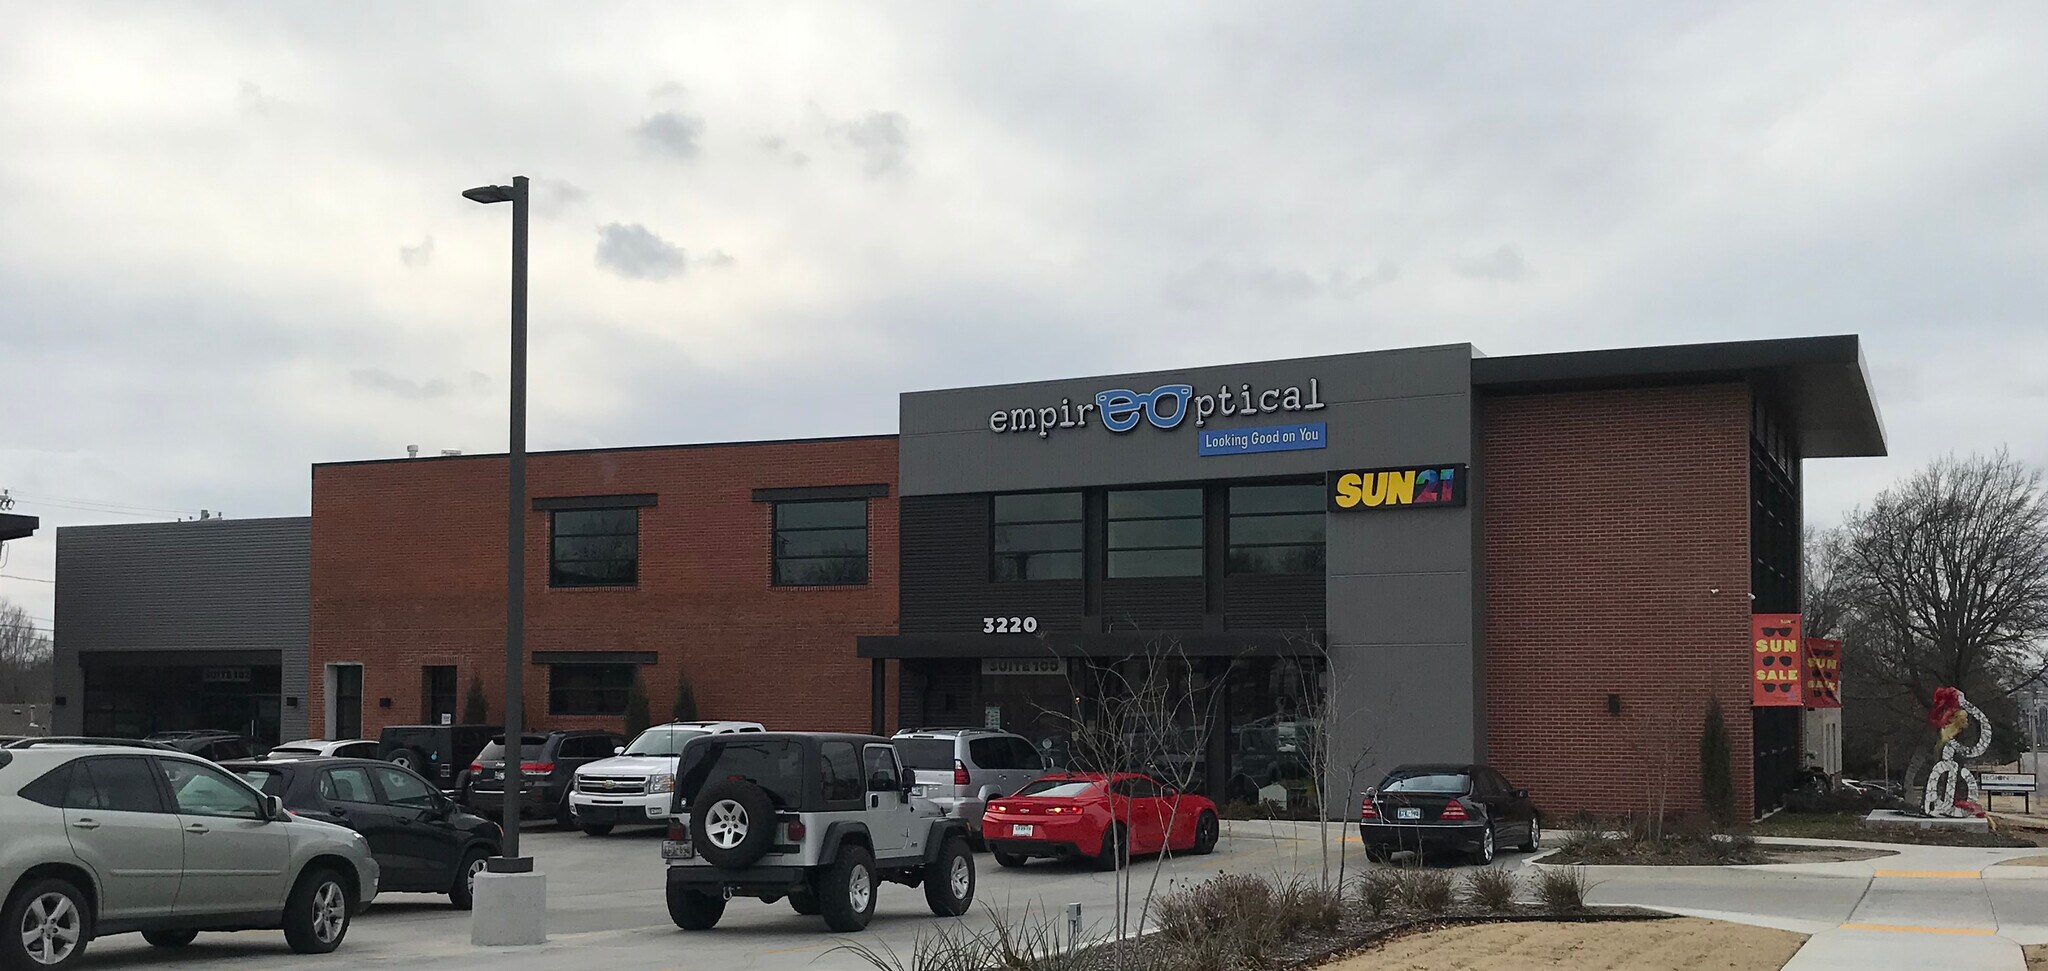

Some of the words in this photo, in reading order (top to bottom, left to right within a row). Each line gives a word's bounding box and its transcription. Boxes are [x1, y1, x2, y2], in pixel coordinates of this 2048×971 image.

[1206, 432, 1249, 449] Looking
[1251, 428, 1279, 444] Good
[1283, 431, 1296, 443] on
[1299, 428, 1319, 441] You
[983, 616, 1038, 633] 3220
[1756, 639, 1797, 653] SUN
[990, 661, 1030, 673] SUITE
[1033, 661, 1059, 673] 100
[1807, 657, 1837, 670] SUN
[1756, 669, 1798, 681] SALE
